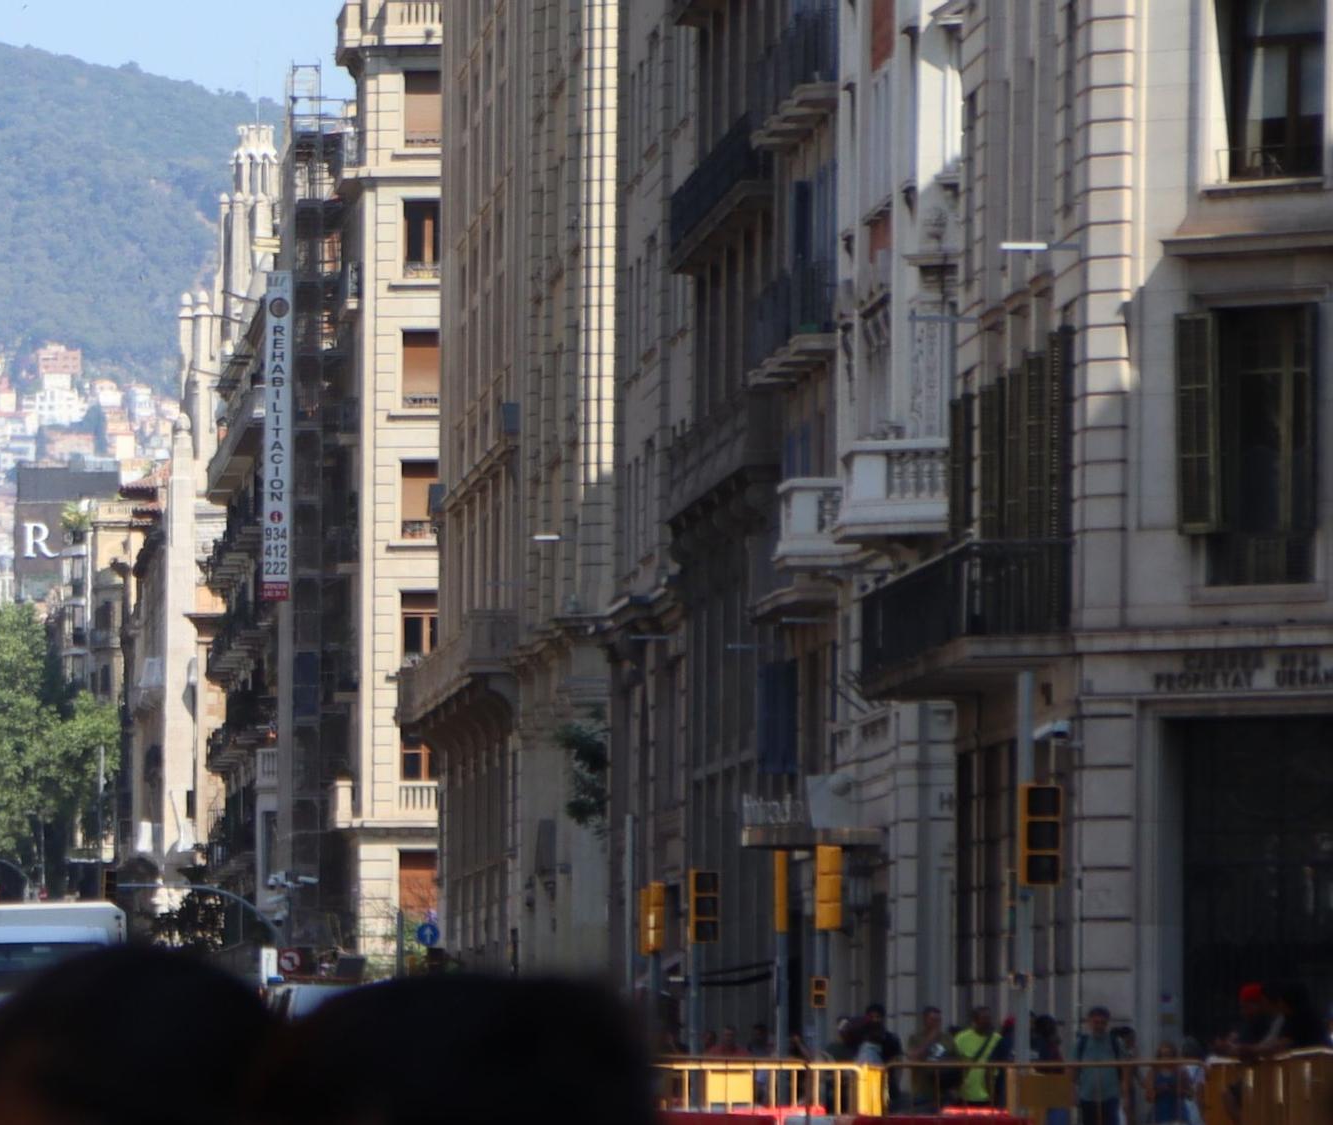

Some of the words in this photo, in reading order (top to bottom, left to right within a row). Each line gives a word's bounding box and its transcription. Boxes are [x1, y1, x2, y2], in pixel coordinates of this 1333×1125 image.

[23, 522, 60, 558] R
[265, 527, 287, 541] 934
[265, 545, 287, 559] 412
[265, 561, 287, 575] 222
